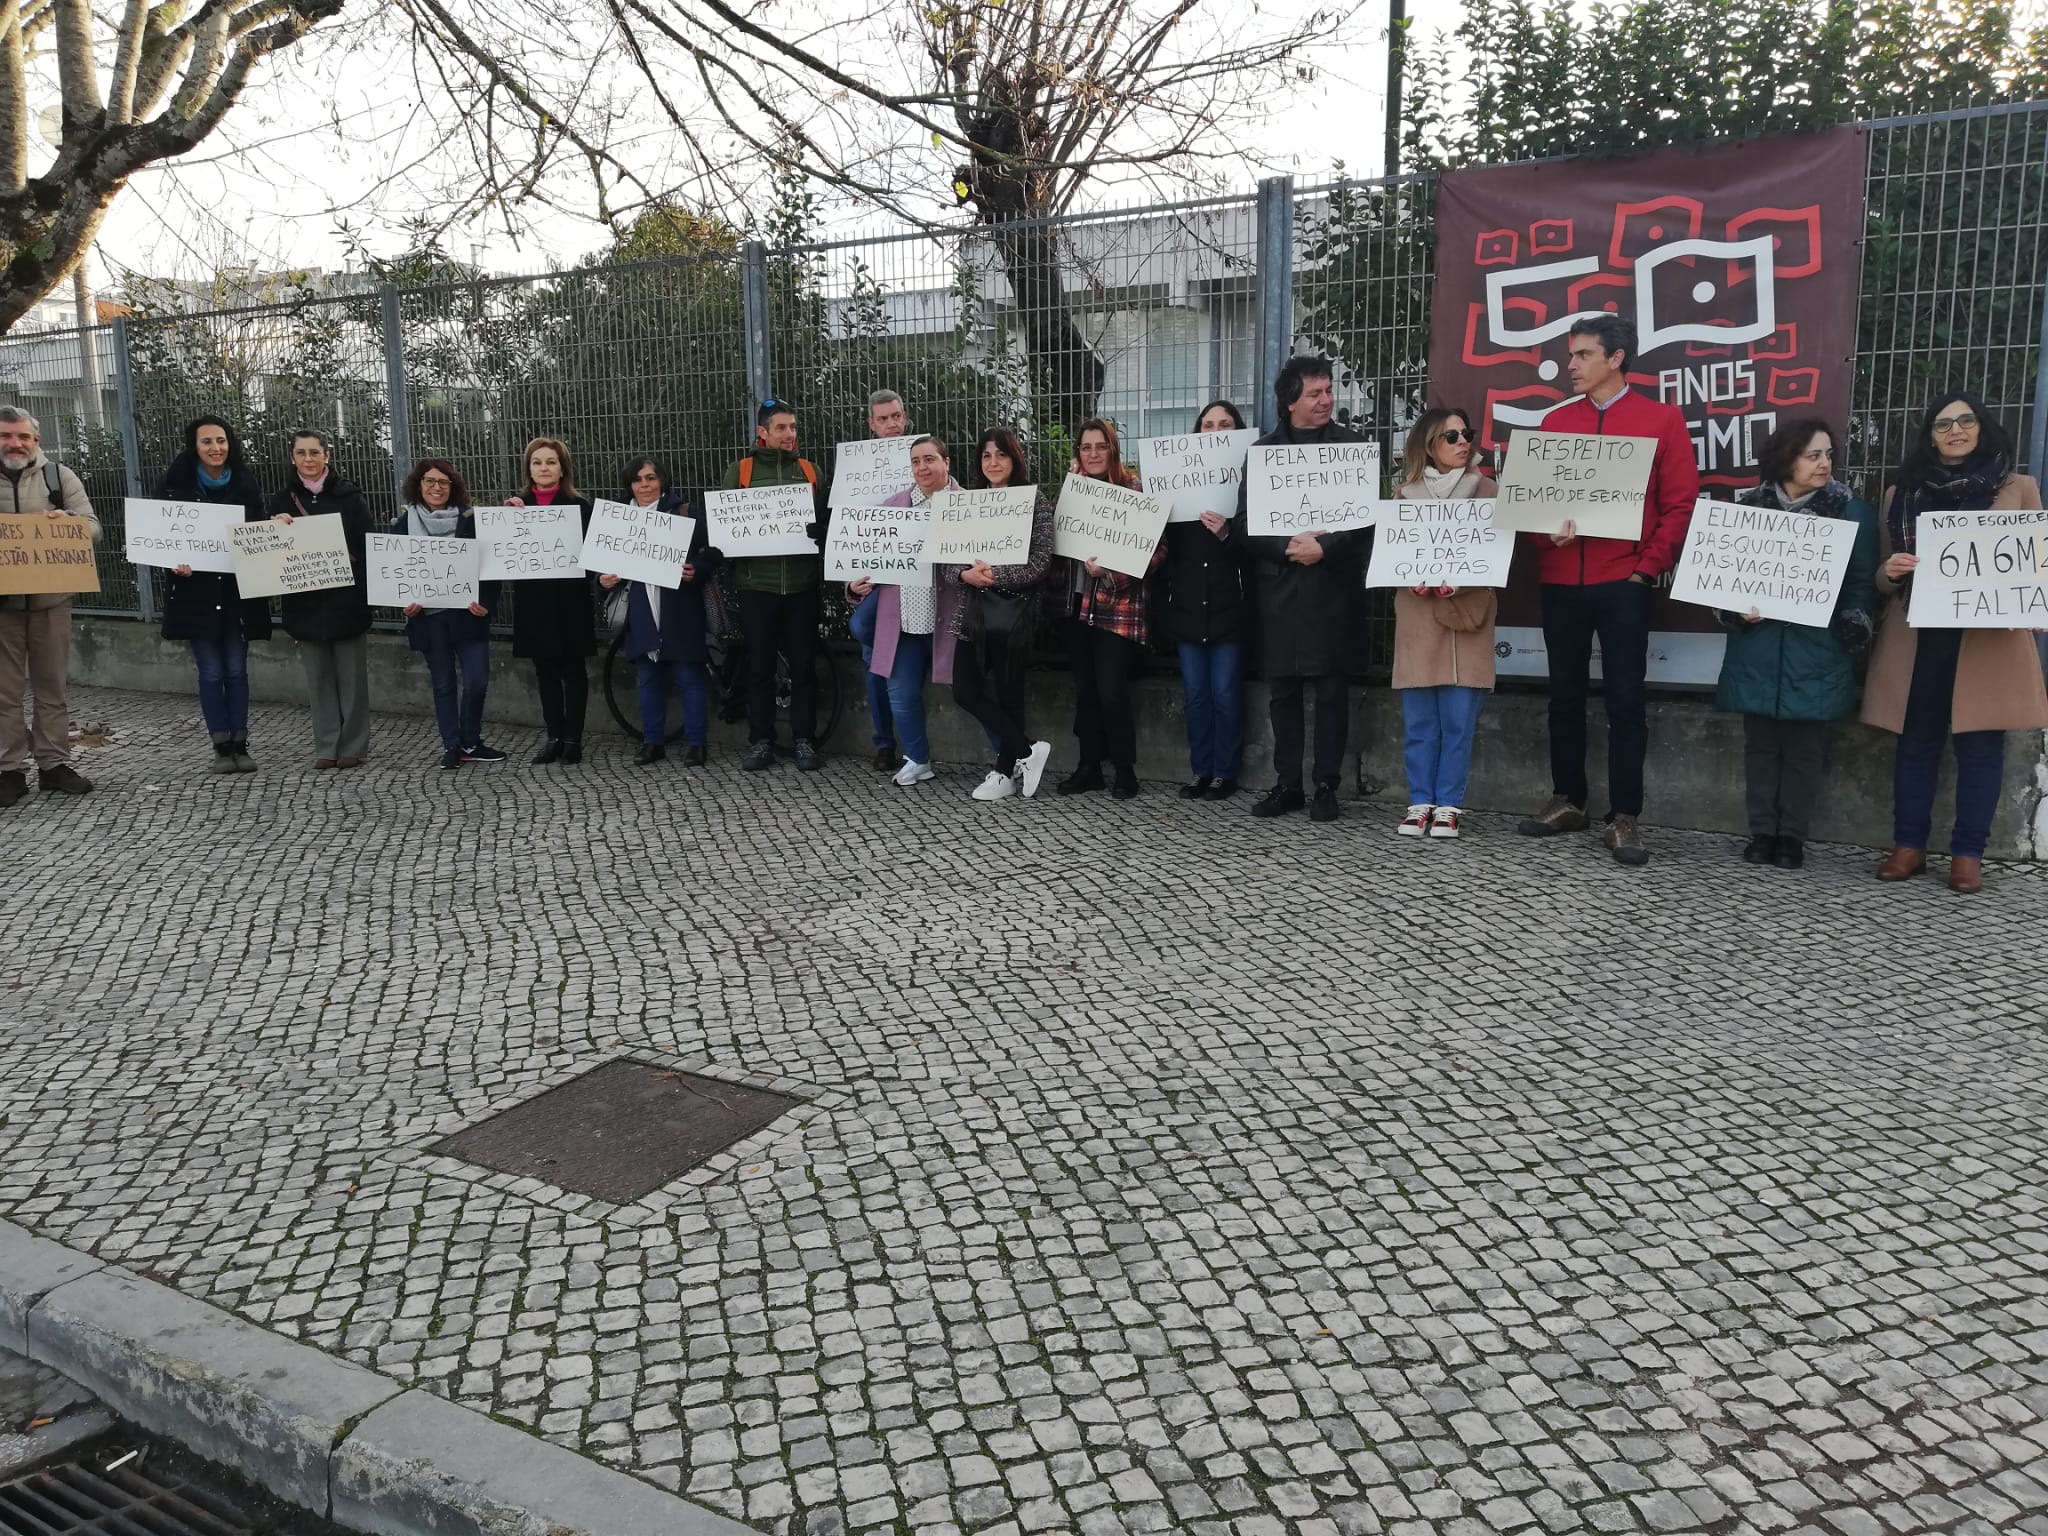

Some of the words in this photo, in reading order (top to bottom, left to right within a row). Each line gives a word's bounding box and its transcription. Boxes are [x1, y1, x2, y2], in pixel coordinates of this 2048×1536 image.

[1659, 359, 1756, 406] ANOS
[841, 444, 865, 457] EM
[1153, 437, 1189, 458] PELO
[1527, 436, 1635, 462] RESPEITO
[874, 457, 890, 469] DA
[1182, 453, 1205, 468] DA
[1265, 448, 1308, 467] PELA
[1149, 466, 1243, 494] PRECARIEDA
[1270, 467, 1370, 491] DEFENDER
[1552, 464, 1597, 482] PELO
[719, 491, 748, 505] PELA
[753, 486, 810, 500] CONTAGEM
[850, 482, 916, 497] DOCENT
[1070, 479, 1160, 514] MUNICIPALIZAÇÃO
[1505, 484, 1566, 505] TEMPO
[1568, 488, 1586, 501] DE
[1589, 488, 1645, 507] SERVIÇO
[711, 503, 772, 518] INTEGRAL
[778, 498, 794, 509] DO
[949, 493, 967, 508] DE
[970, 491, 1008, 506] LUTO
[1300, 493, 1312, 510] A
[161, 504, 200, 520] NÃO
[481, 511, 508, 527] EM
[513, 508, 568, 526] DEFESA
[600, 501, 639, 522] PELO
[645, 513, 673, 531] FIM
[840, 507, 931, 522] PROFESSORES
[942, 508, 972, 523] PELA
[1091, 503, 1128, 526] NEM
[1270, 501, 1370, 529] PROFISSÃO
[1399, 499, 1494, 524] EXTINÇÃO
[1932, 515, 1969, 531] NÃO
[1977, 511, 2048, 527] ESQUECE
[34, 523, 43, 540] A
[50, 523, 89, 540] LUTAR
[170, 524, 196, 535] AO
[512, 526, 532, 538] DA
[731, 525, 752, 539] 6A
[759, 523, 781, 536] 6M
[839, 525, 849, 536] A
[857, 524, 899, 538] LUTAR
[1707, 506, 1834, 540] ELIMINAÇÃO
[627, 525, 648, 542] DA
[1056, 515, 1156, 553] RECAUCHUTADA
[1386, 530, 1421, 545] DAS
[1427, 526, 1497, 545] VAGAS
[130, 536, 183, 552] SOBRE
[373, 536, 404, 551] EM
[409, 538, 468, 555] DEFESA
[493, 536, 566, 559] ESCOLA
[595, 533, 688, 564] PRECARIEDADE
[832, 538, 894, 554] TAMBÉM
[940, 535, 1024, 555] HUMILHAÇÃO
[1432, 546, 1468, 560] DAS
[33, 549, 42, 565] A
[44, 547, 94, 567] ENSINAR!
[286, 554, 300, 563] NA
[325, 550, 345, 559] DAS
[332, 558, 340, 566] O
[403, 556, 427, 566] DA
[503, 552, 580, 574] PÚBLICA
[834, 558, 844, 571] A
[851, 557, 919, 571] ENSINAR
[1939, 541, 1981, 578] 6A
[279, 567, 332, 584] PROFESSOR
[381, 564, 456, 579] ESCOLA
[1394, 559, 1490, 580] QUOTAS
[397, 582, 473, 599] PÚBLICA
[1696, 573, 1723, 592] NA
